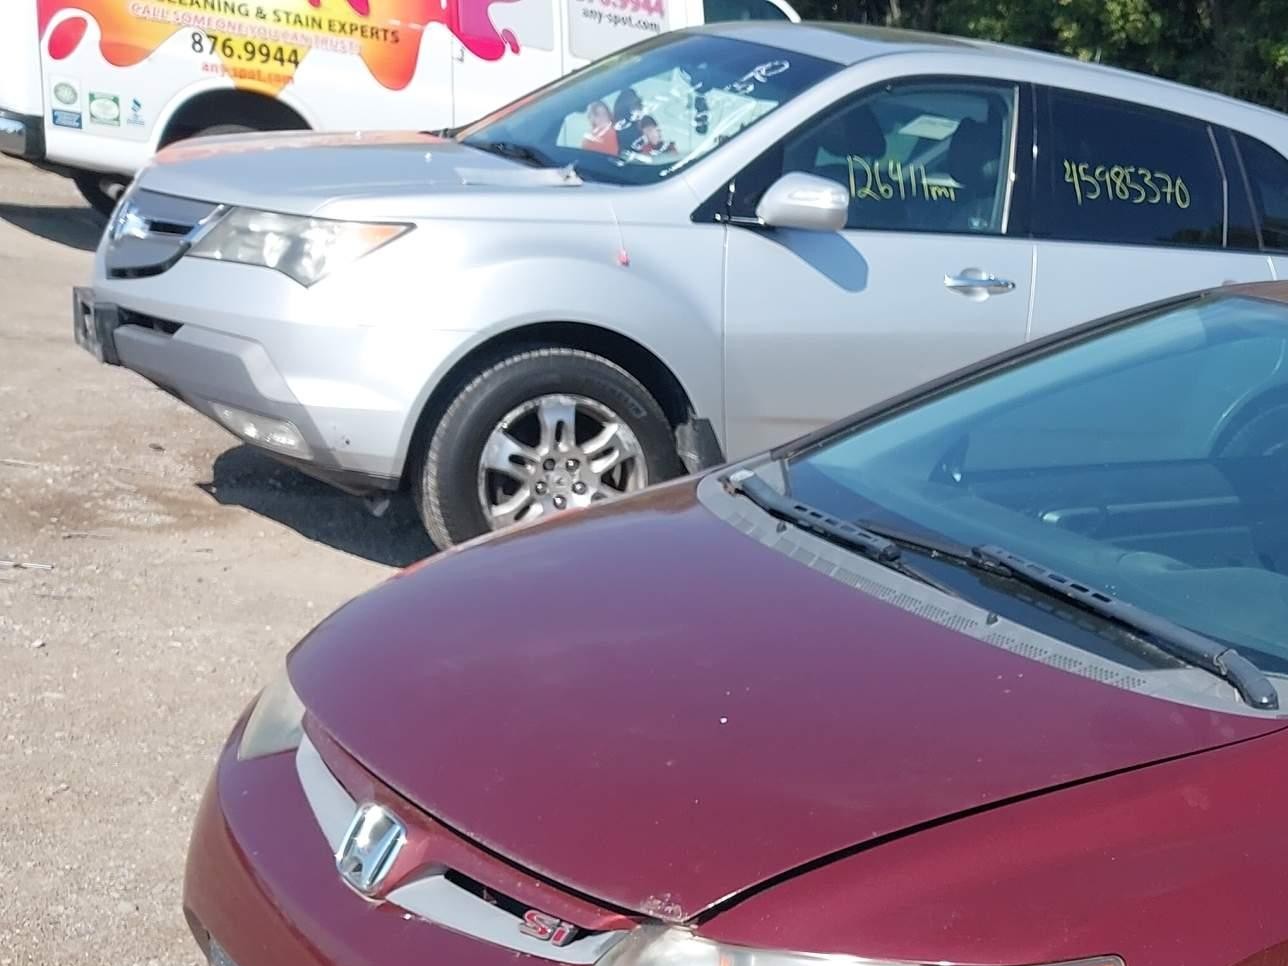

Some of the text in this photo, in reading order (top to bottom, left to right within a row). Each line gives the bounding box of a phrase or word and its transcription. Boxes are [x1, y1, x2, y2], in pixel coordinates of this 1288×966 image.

[157, 0, 400, 43] ANING & STAIN EXPERTS
[191, 32, 299, 70] 876.9944
[1063, 159, 1191, 209] 45985370
